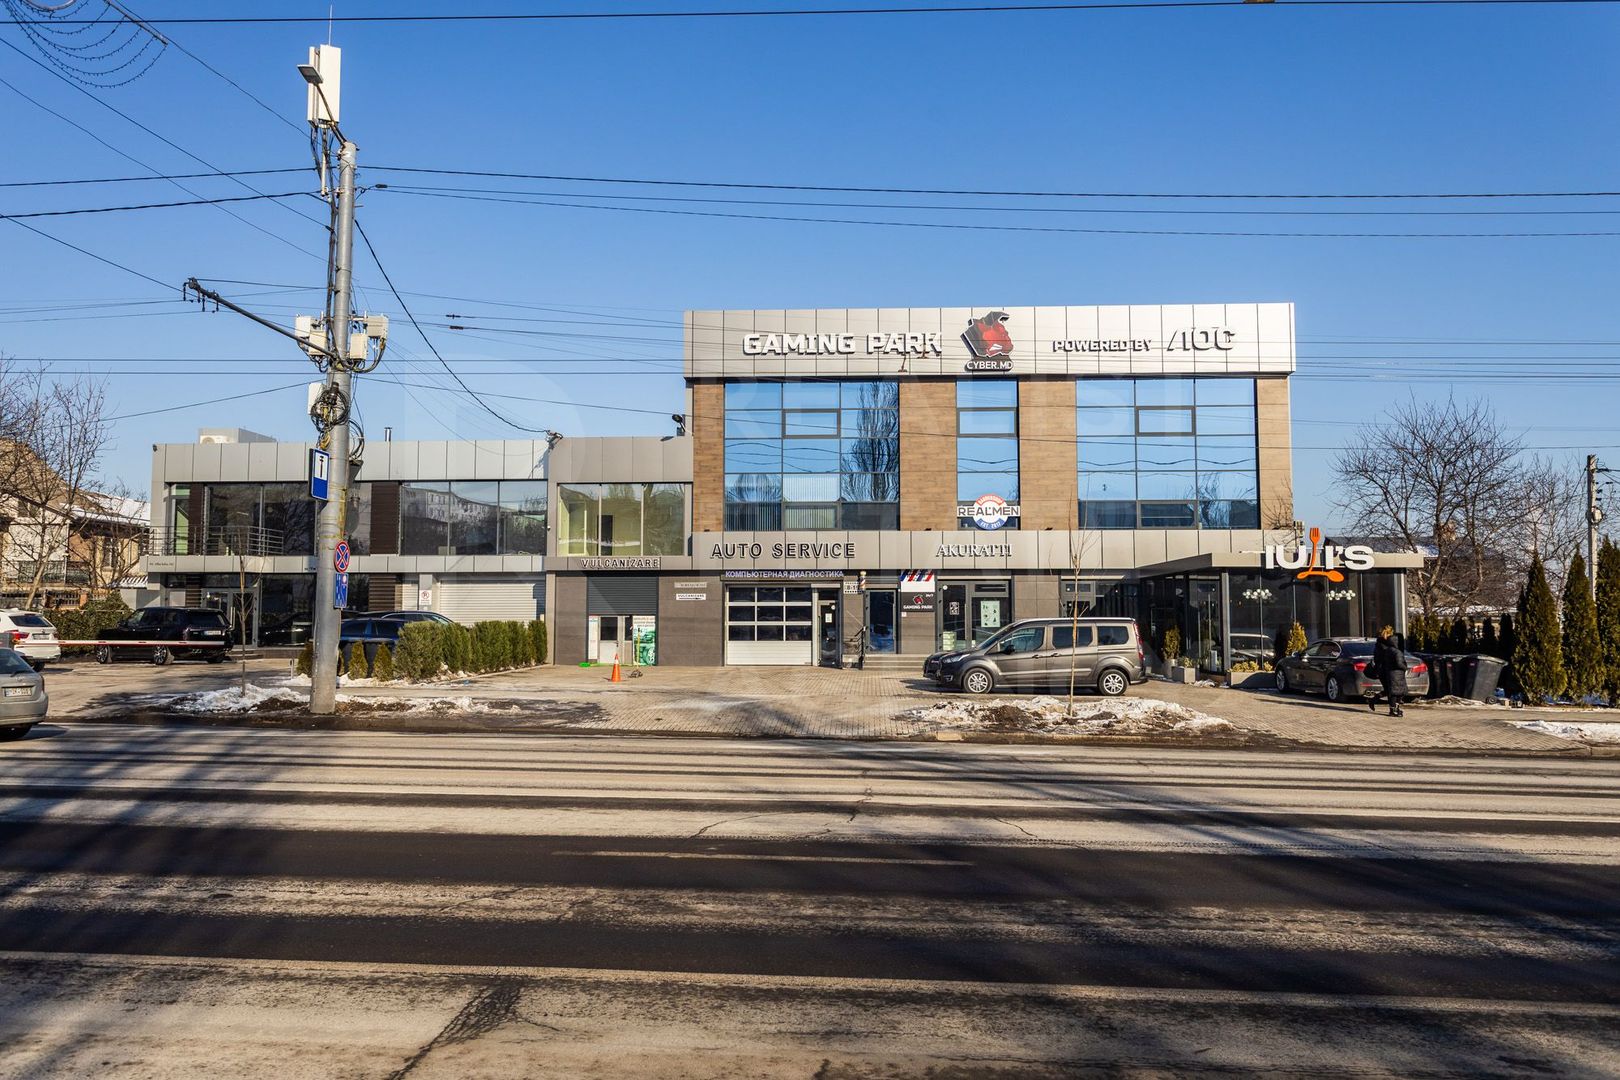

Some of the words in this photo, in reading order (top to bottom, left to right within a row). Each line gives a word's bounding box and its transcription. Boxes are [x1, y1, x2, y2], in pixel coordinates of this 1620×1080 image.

[743, 333, 856, 355] GAMING
[867, 332, 943, 355] PARK
[1053, 340, 1129, 352] POWERED
[1132, 340, 1152, 352] BY
[966, 360, 1014, 370] CYBER.MD
[711, 543, 763, 559] AUTO
[772, 543, 856, 559] SERVICE
[936, 544, 1013, 557] AKURATTI
[581, 557, 660, 569] VULCANIZARE
[725, 570, 789, 578] КОМПЬЮТЕРНАЯ
[789, 570, 844, 578] ДИАГНОСТИКА
